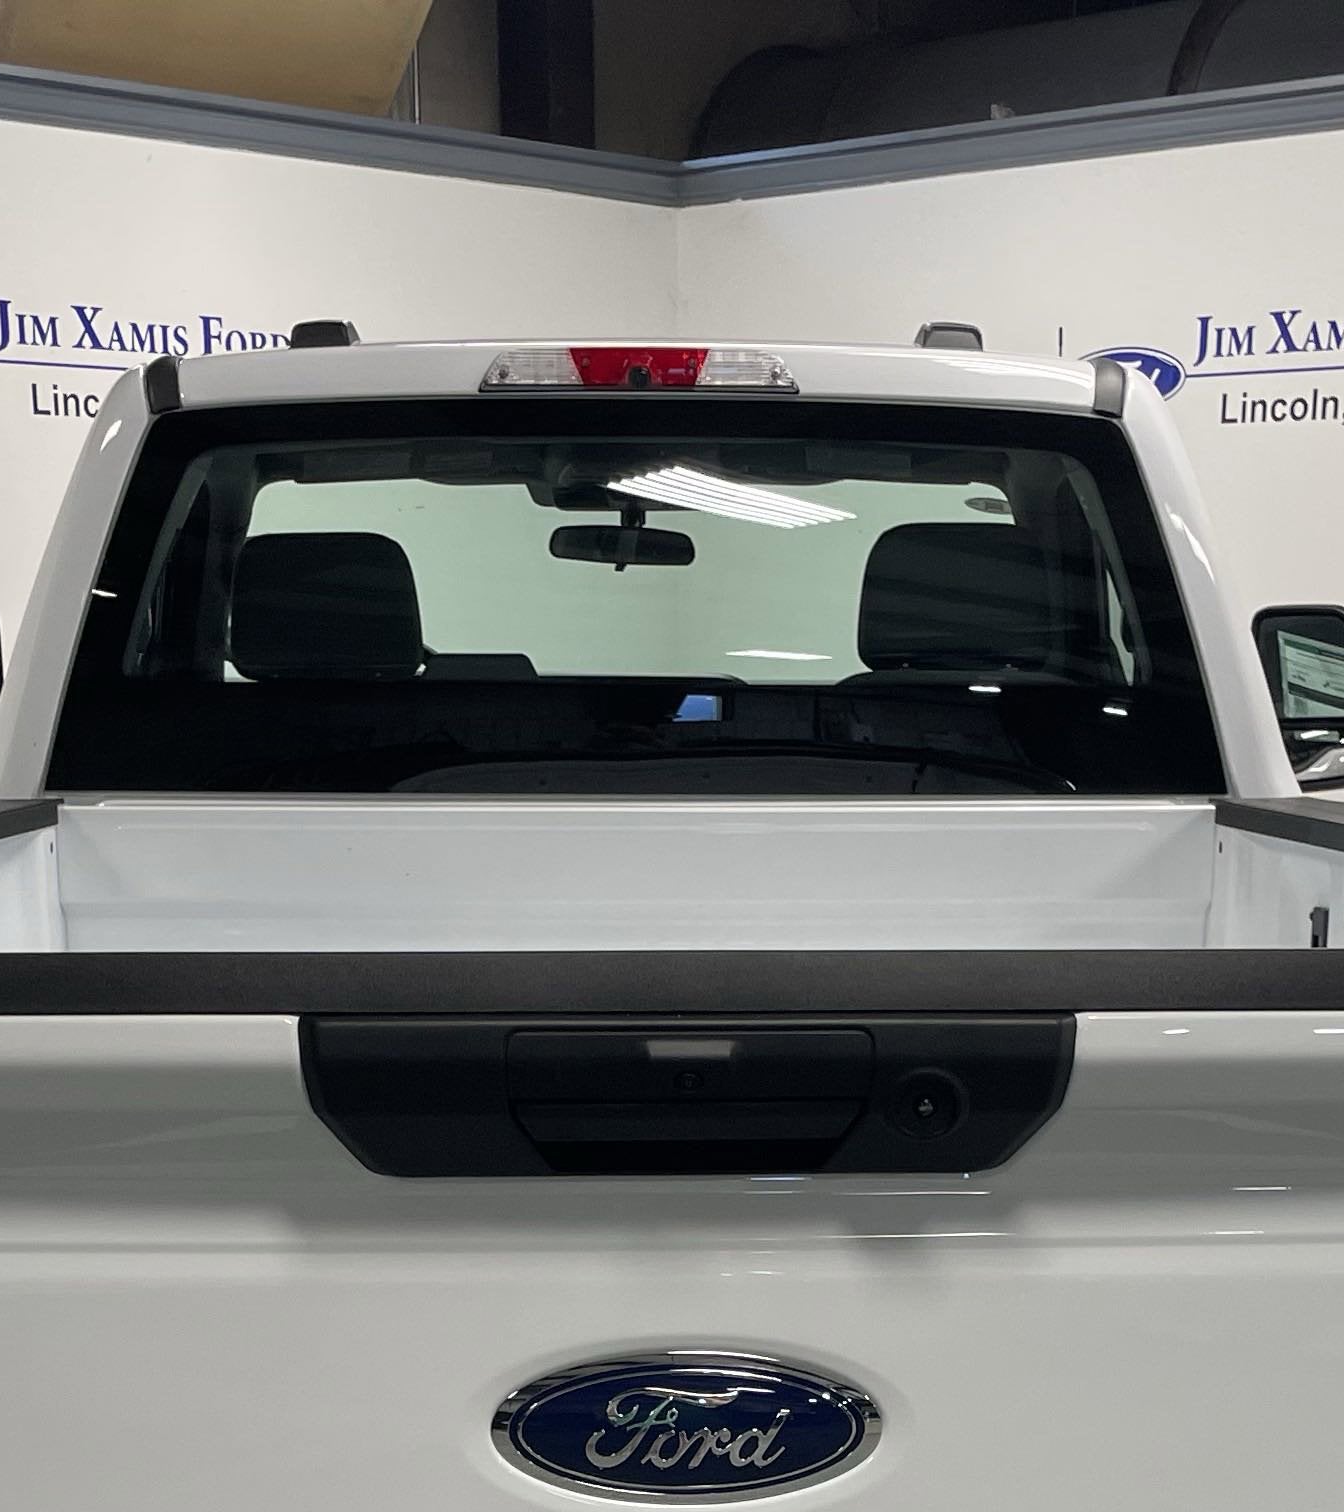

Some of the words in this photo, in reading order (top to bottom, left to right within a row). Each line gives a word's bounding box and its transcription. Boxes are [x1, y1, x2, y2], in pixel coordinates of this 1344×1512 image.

[70, 305, 189, 356] XAMIS
[1193, 315, 1255, 367] JIM
[585, 1387, 791, 1470] Ford
